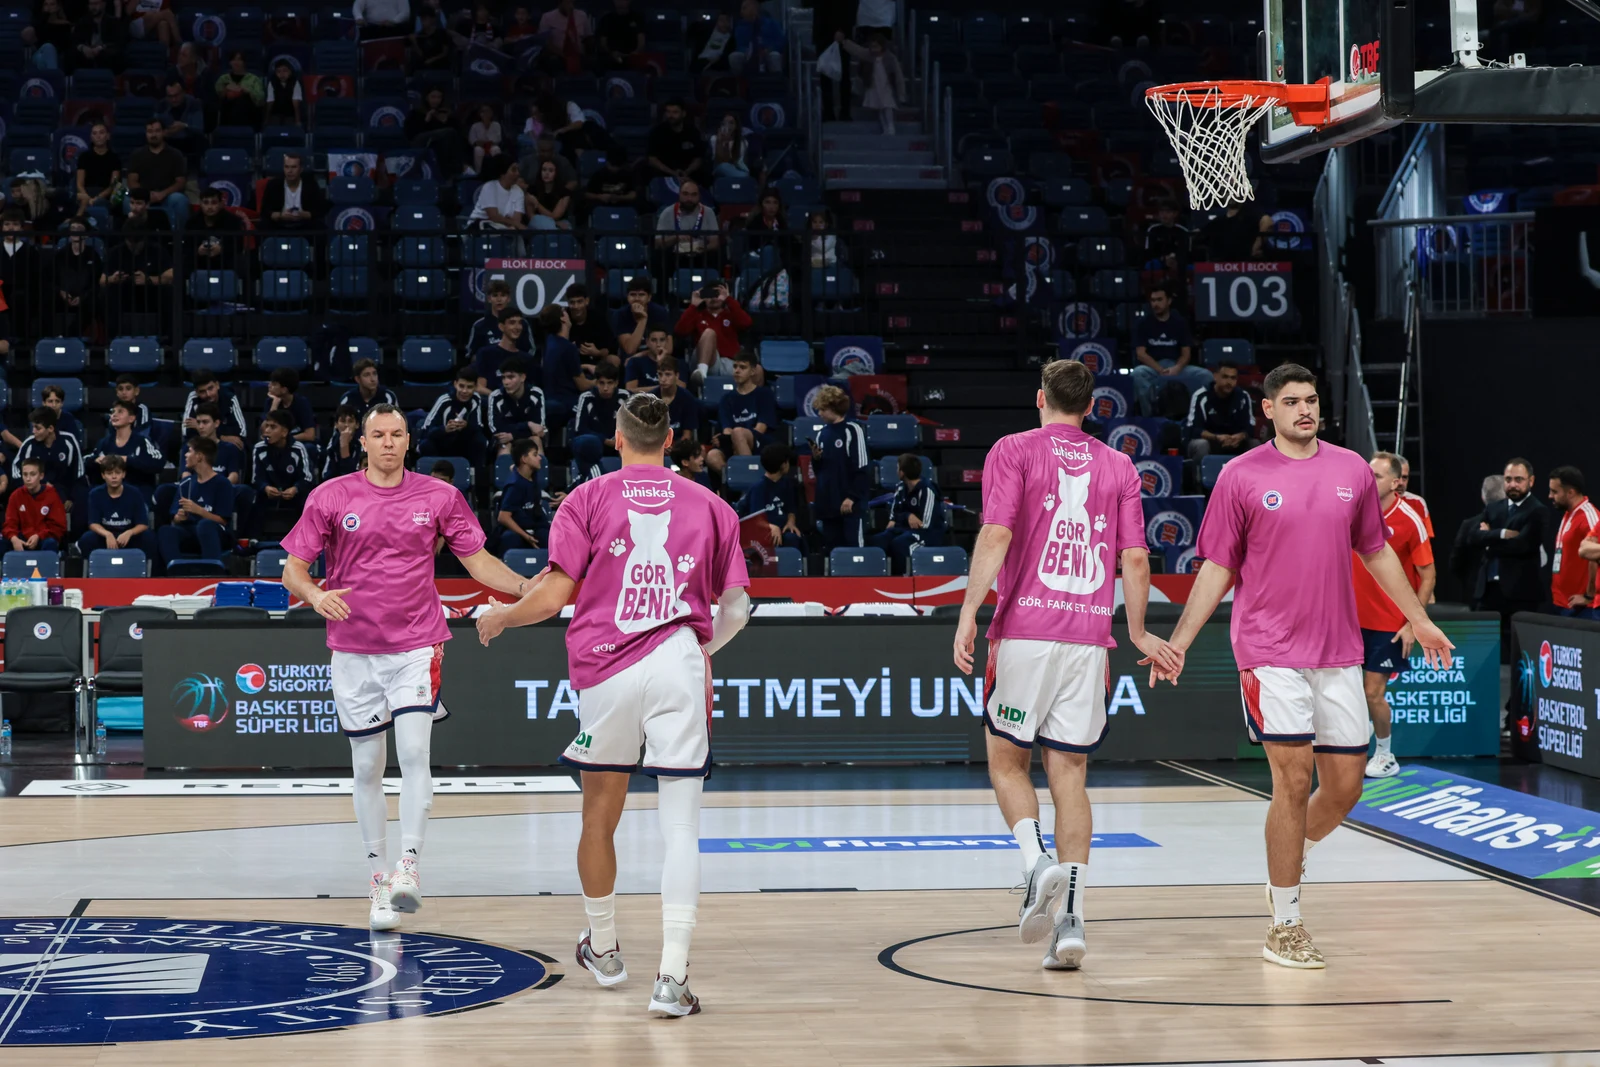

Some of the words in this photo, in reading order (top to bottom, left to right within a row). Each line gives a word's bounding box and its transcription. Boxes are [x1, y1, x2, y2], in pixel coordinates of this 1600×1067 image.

[1360, 40, 1380, 76] TBF
[502, 260, 528, 269] BLOK
[535, 260, 567, 269] BLOCK
[1213, 263, 1240, 272] BLOK
[1247, 263, 1278, 272] BLOCK
[1202, 276, 1288, 317] 103
[1052, 446, 1093, 461] whiskas
[622, 486, 675, 499] whiskas
[1056, 517, 1085, 542] GÖR
[630, 560, 666, 585] GÖR
[1018, 595, 1044, 608] GÖR.
[1047, 599, 1073, 611] FARK
[1402, 670, 1466, 683] SİGORTA
[997, 703, 1027, 725] HDI
[1434, 705, 1467, 723] LİGİ
[1538, 697, 1587, 731] BASKETBOL
[236, 716, 298, 733] SÜPER
[303, 716, 338, 733] LİGİ
[1538, 724, 1565, 755] SÜPER
[1379, 785, 1564, 849] finans
